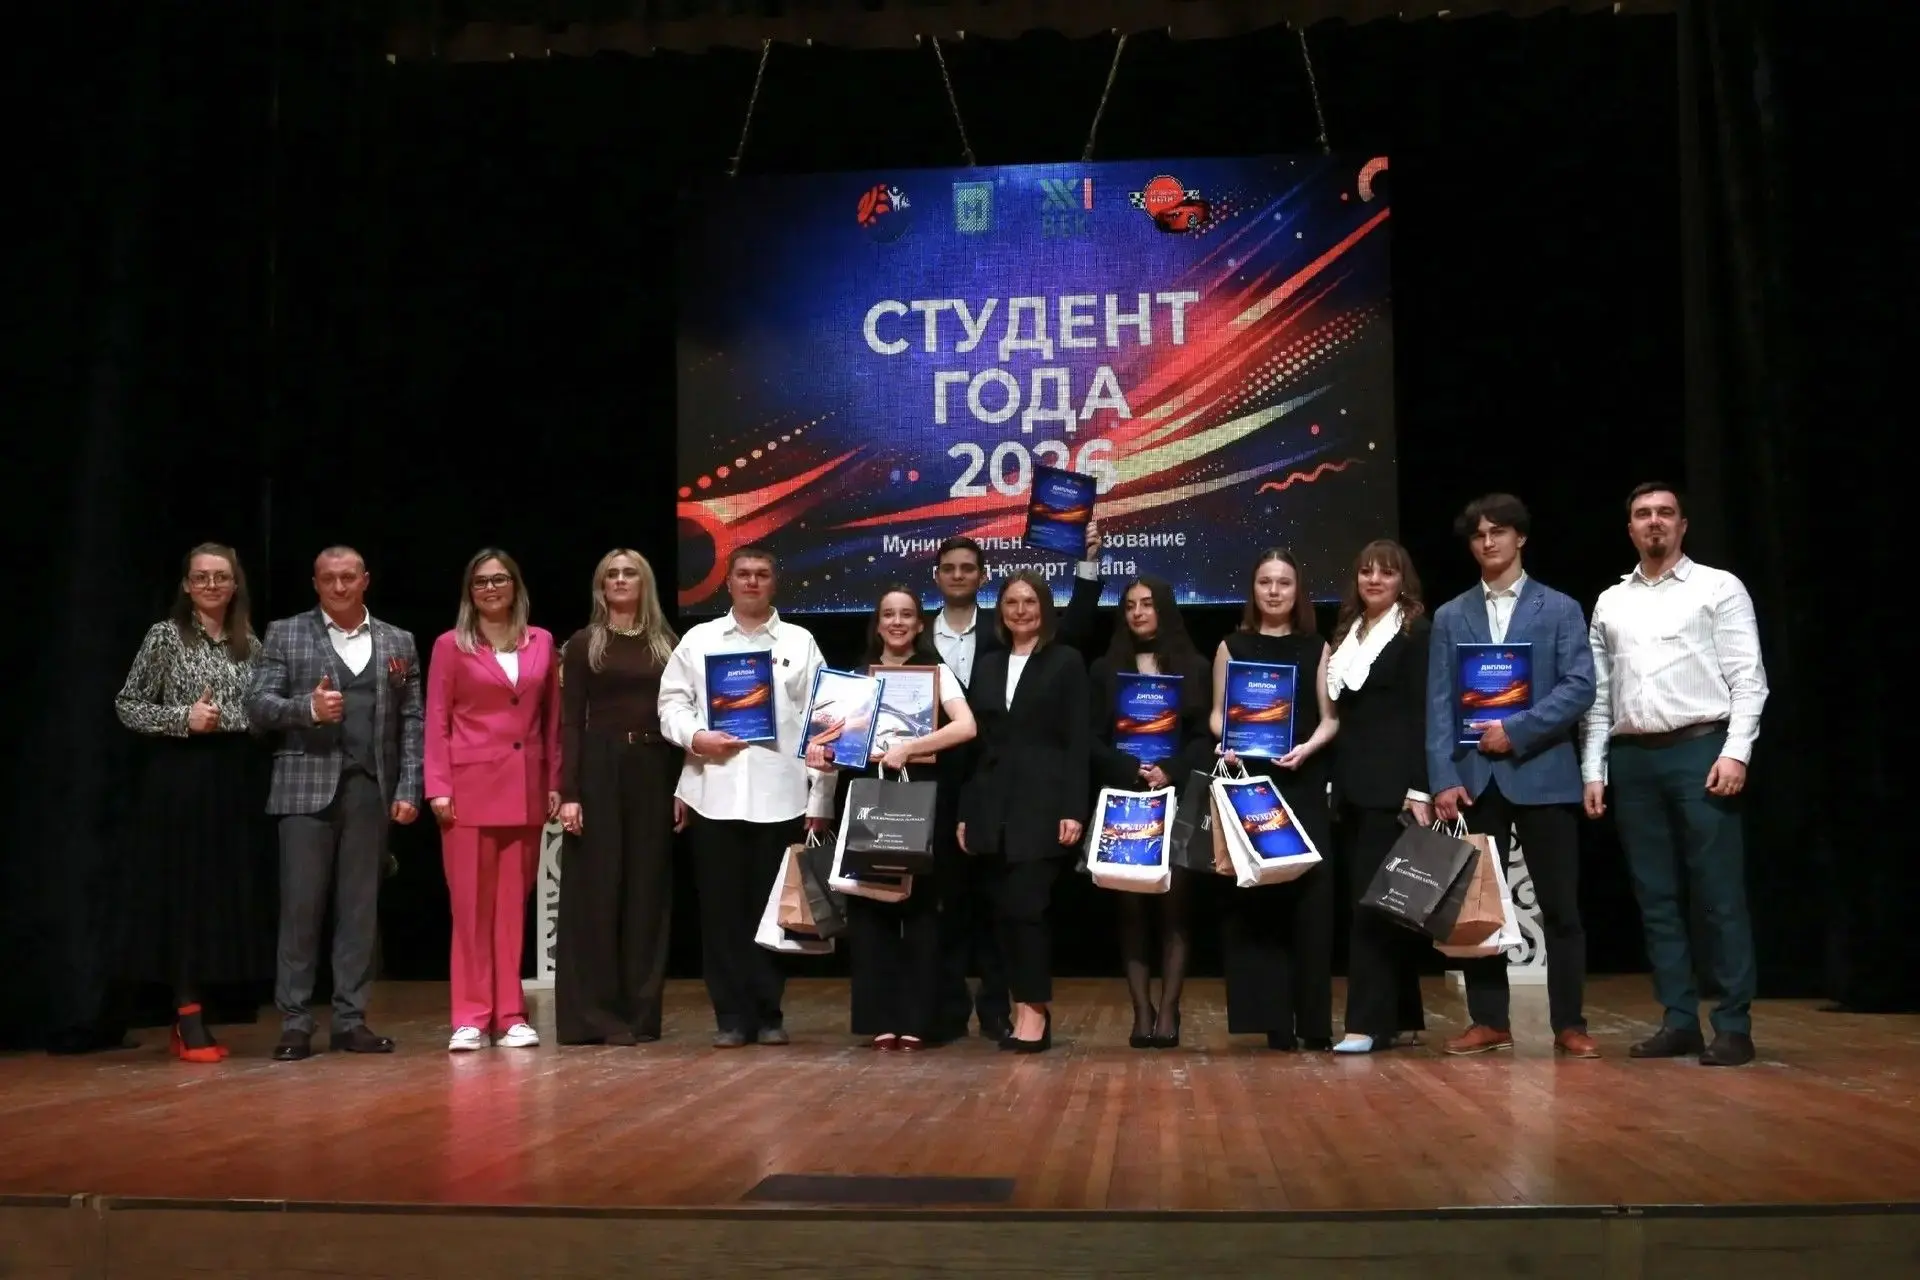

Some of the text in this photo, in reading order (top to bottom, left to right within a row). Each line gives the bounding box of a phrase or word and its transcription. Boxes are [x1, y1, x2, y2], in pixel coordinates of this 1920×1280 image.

[863, 291, 1199, 361] СТУДЕНТ
[934, 366, 1132, 433] ГОДА
[883, 532, 1187, 557] Муниальн зование
